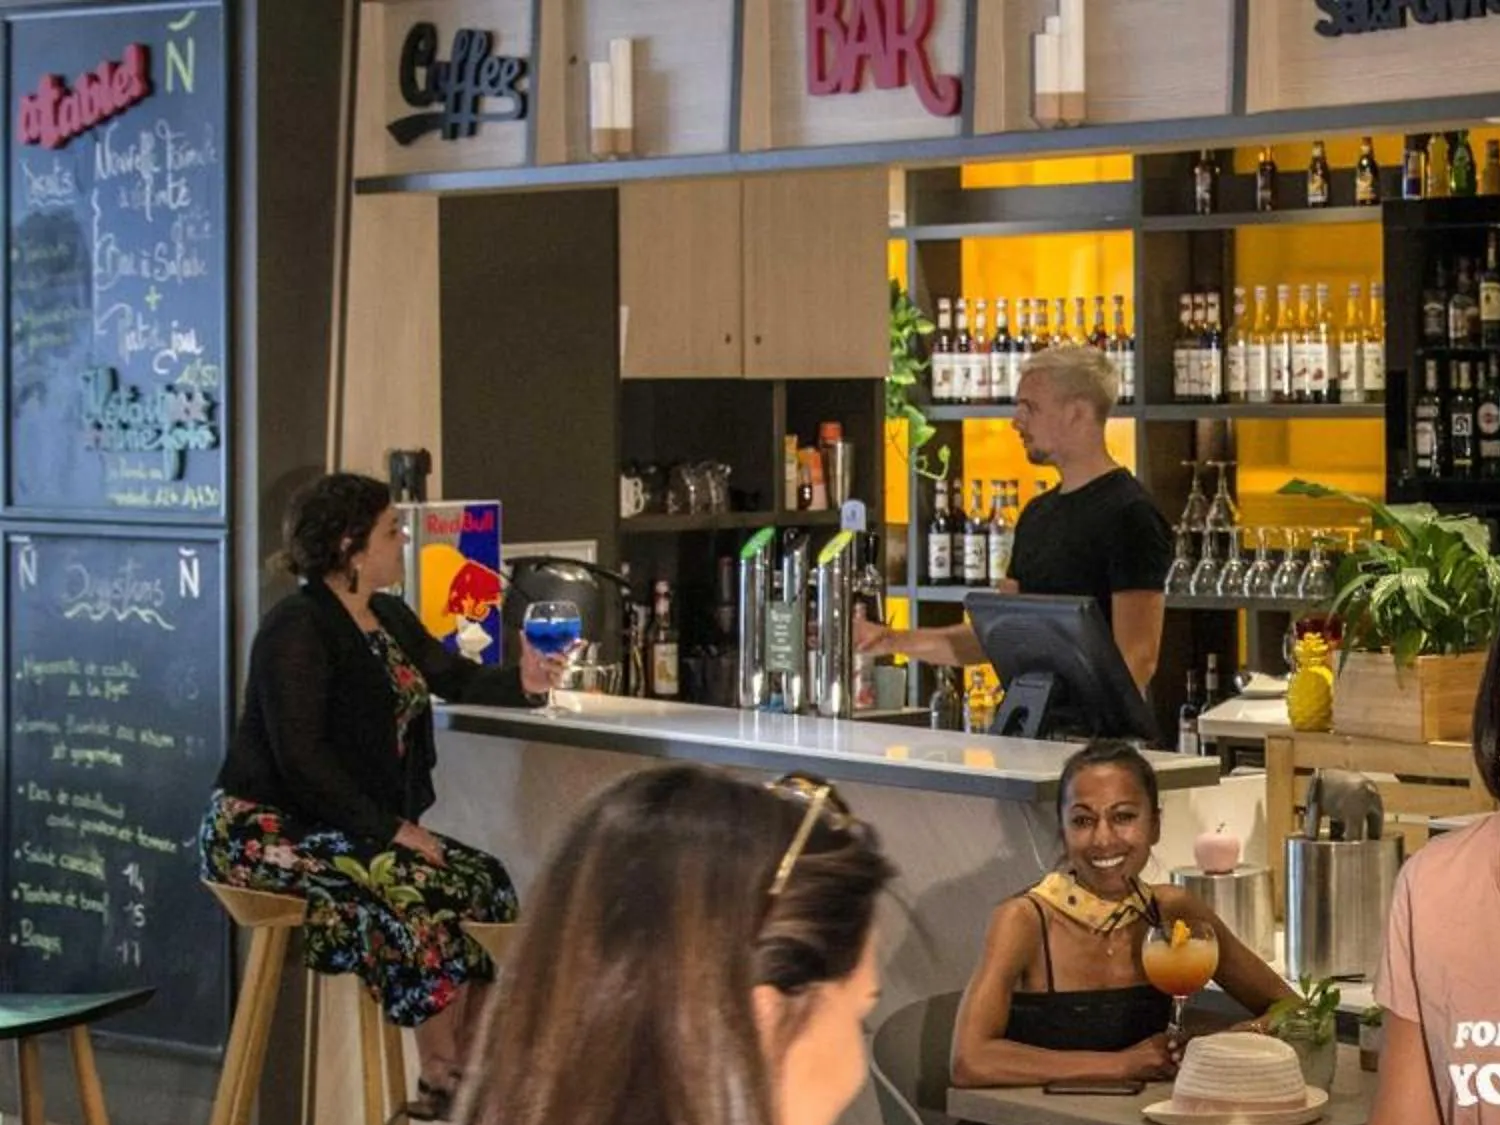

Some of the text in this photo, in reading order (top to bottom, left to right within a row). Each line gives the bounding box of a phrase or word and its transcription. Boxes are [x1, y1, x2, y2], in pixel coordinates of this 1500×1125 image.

[807, 0, 962, 117] BAR
[425, 509, 494, 534] Red Bull
